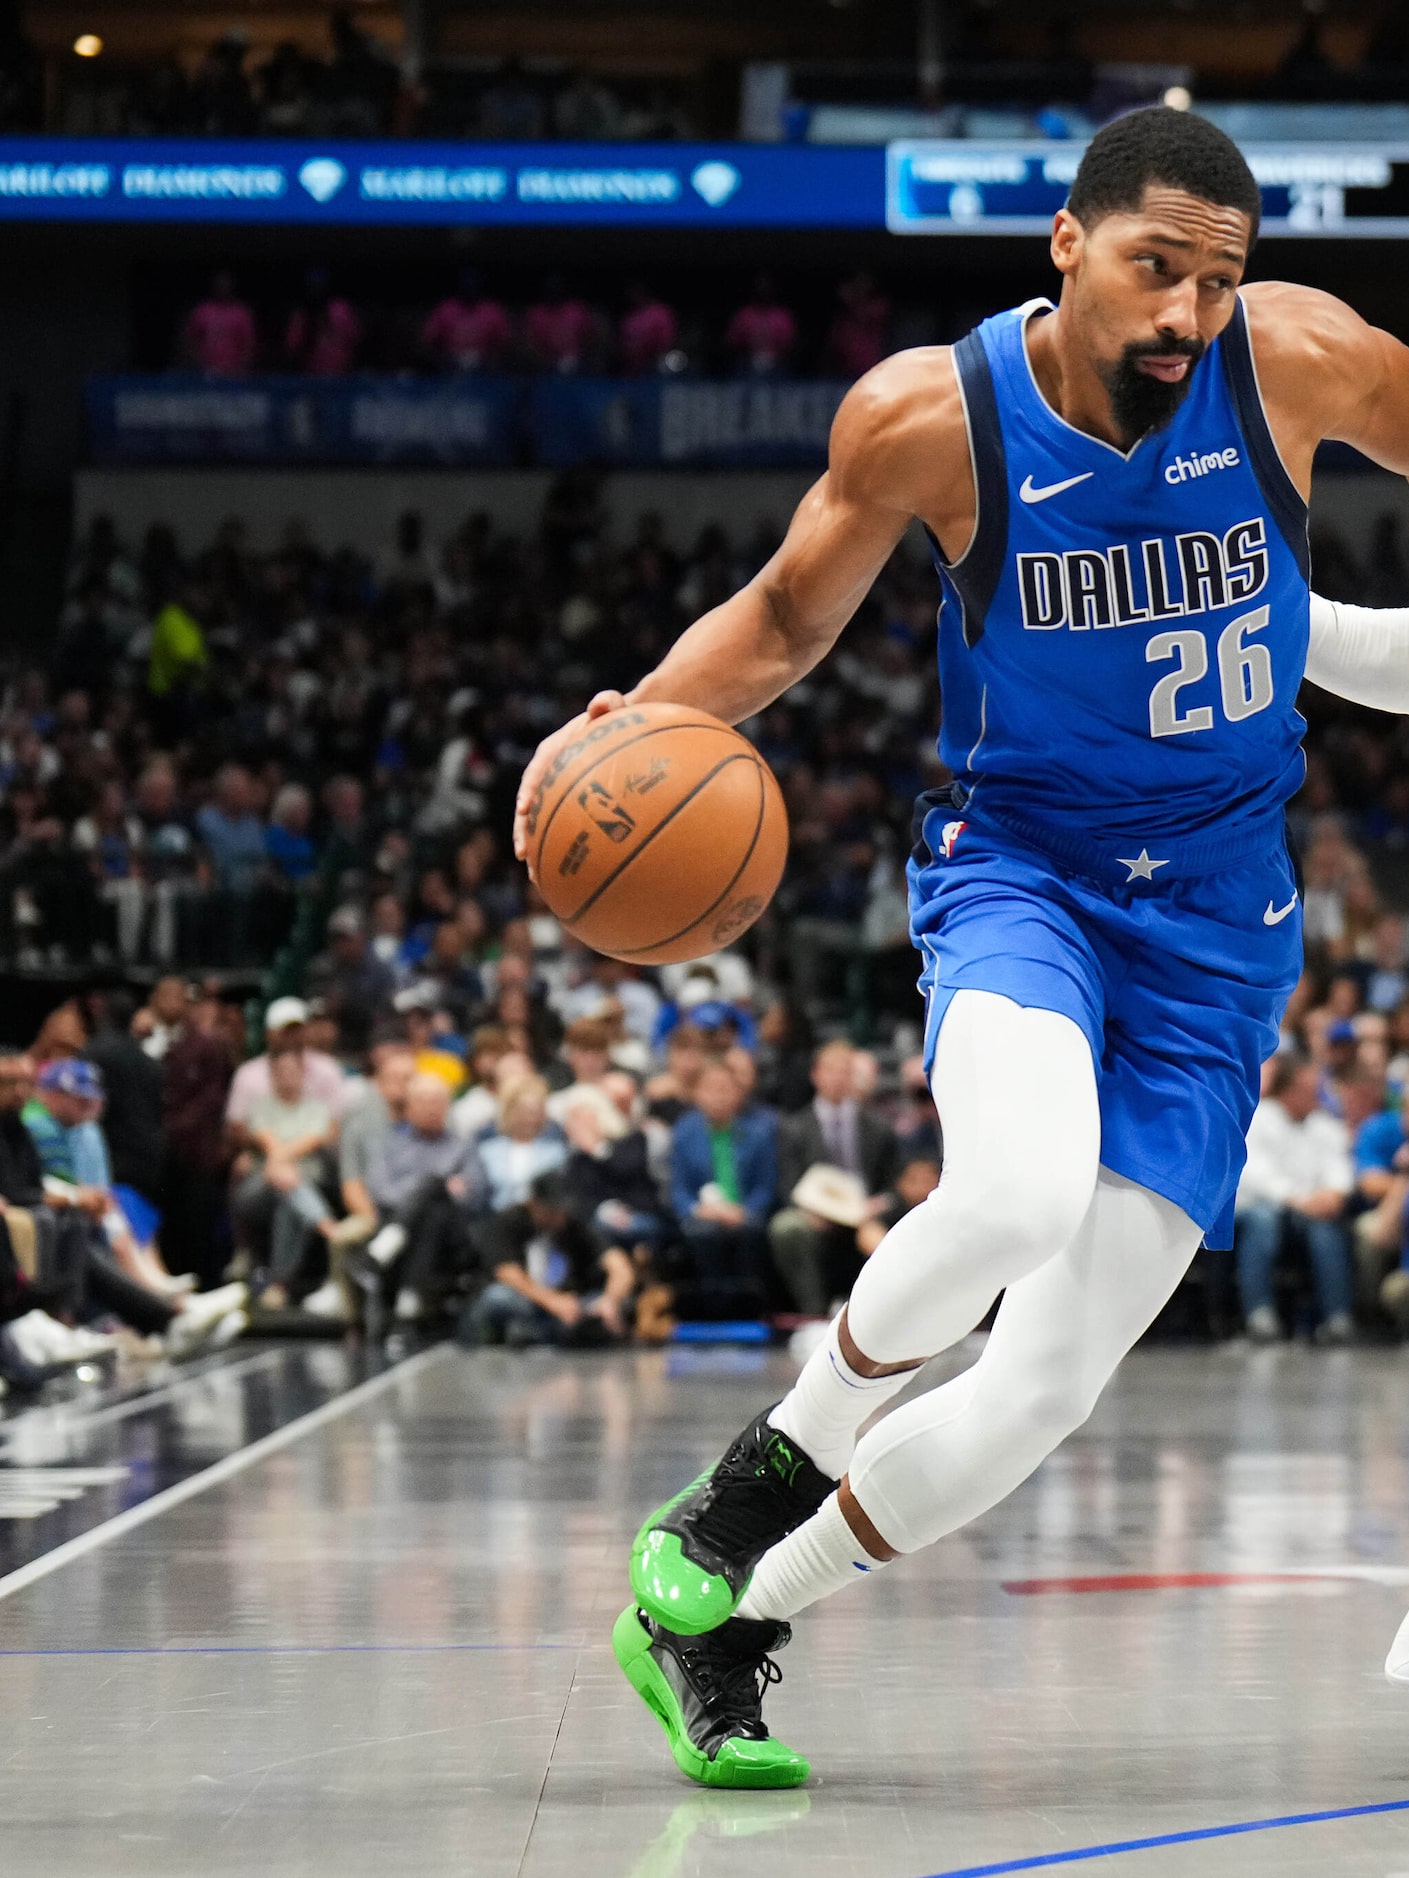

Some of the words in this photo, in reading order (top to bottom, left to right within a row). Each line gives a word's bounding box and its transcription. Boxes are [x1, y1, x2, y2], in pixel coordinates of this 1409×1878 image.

[1165, 447, 1240, 484] chime
[1016, 517, 1270, 631] DALLAS
[1146, 604, 1274, 738] 26
